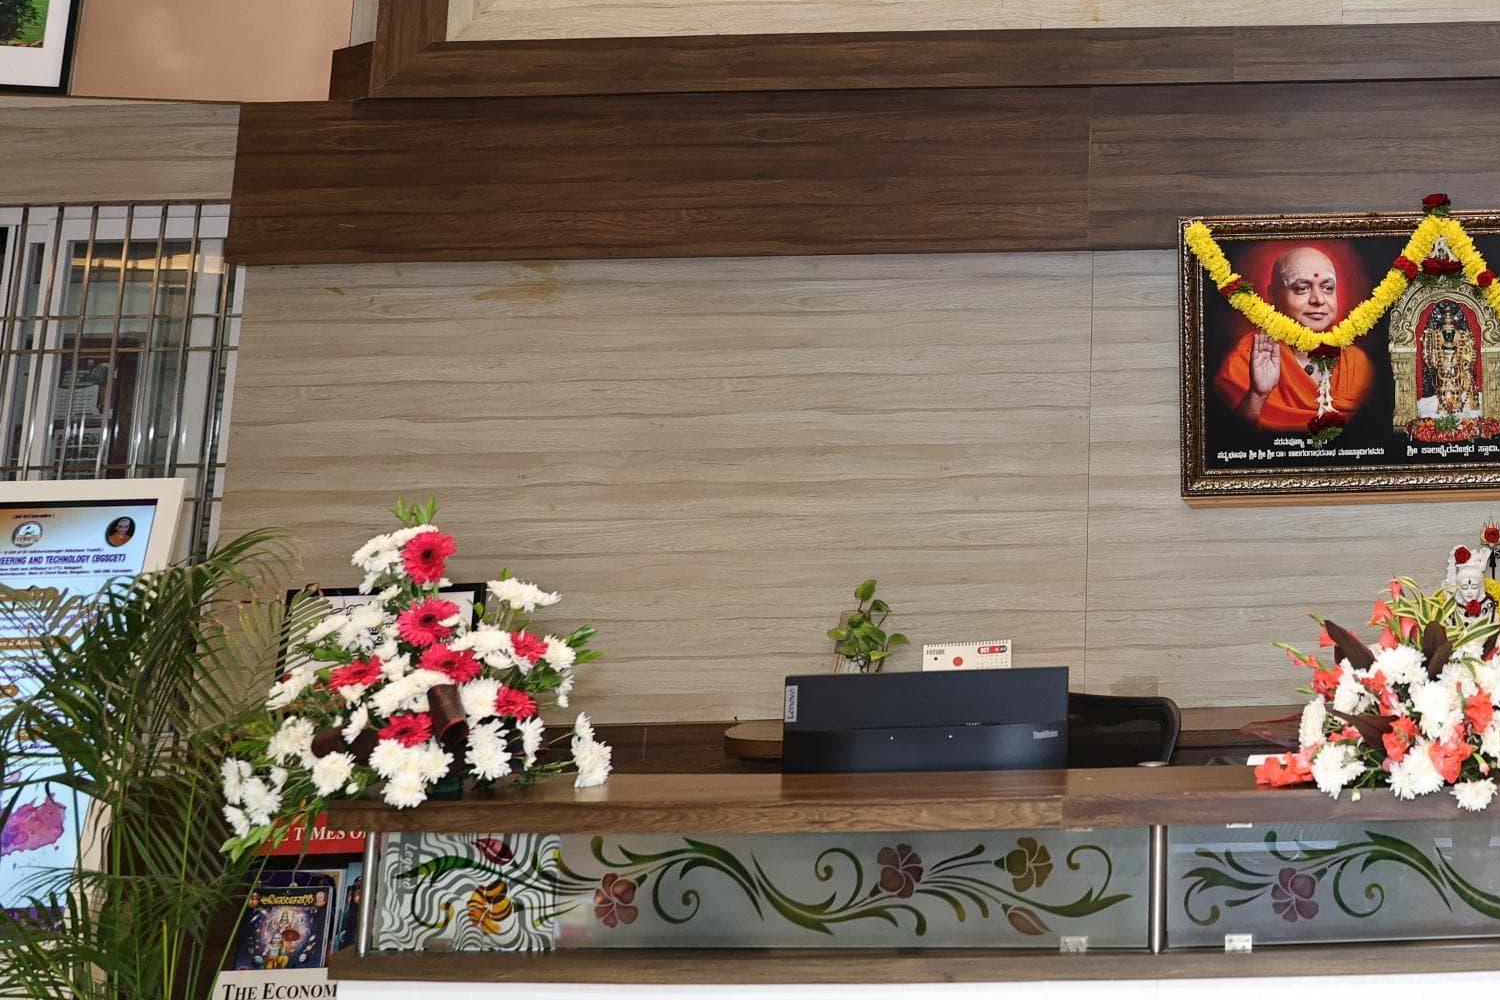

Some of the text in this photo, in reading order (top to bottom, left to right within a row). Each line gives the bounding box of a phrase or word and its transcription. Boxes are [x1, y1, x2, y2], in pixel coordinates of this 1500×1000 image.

[1406, 445, 1418, 457] ಶ್ರೀ
[0, 556, 27, 564] EERING
[28, 555, 44, 564] AND
[46, 554, 90, 564] TECHNOLOGY
[787, 687, 796, 720] Lenovo
[294, 826, 346, 841] TMES
[222, 984, 257, 1000] THE
